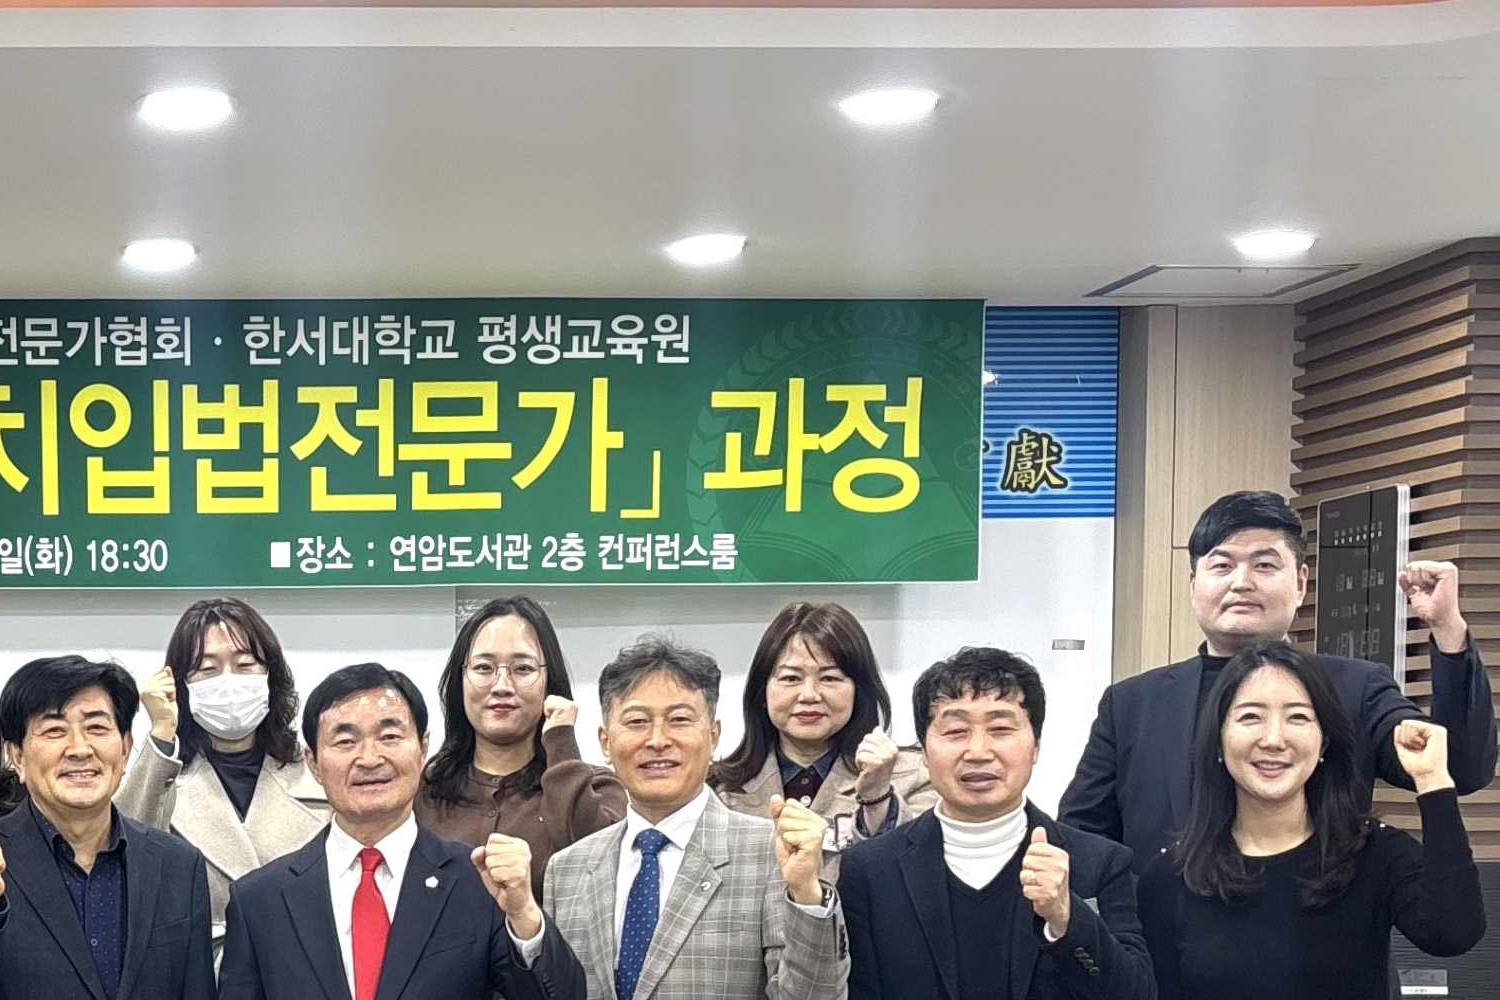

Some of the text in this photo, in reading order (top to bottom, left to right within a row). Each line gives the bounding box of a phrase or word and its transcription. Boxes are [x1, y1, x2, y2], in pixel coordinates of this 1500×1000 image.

[243, 315, 459, 366] 한서대학교
[477, 314, 690, 365] 평생교육원
[703, 377, 924, 513] 과정
[86, 539, 169, 573] 18:30
[296, 535, 354, 574] 장소
[389, 532, 532, 572] 연암도서관
[541, 532, 587, 572] 2층
[597, 532, 739, 571] 컨퍼런스룸
